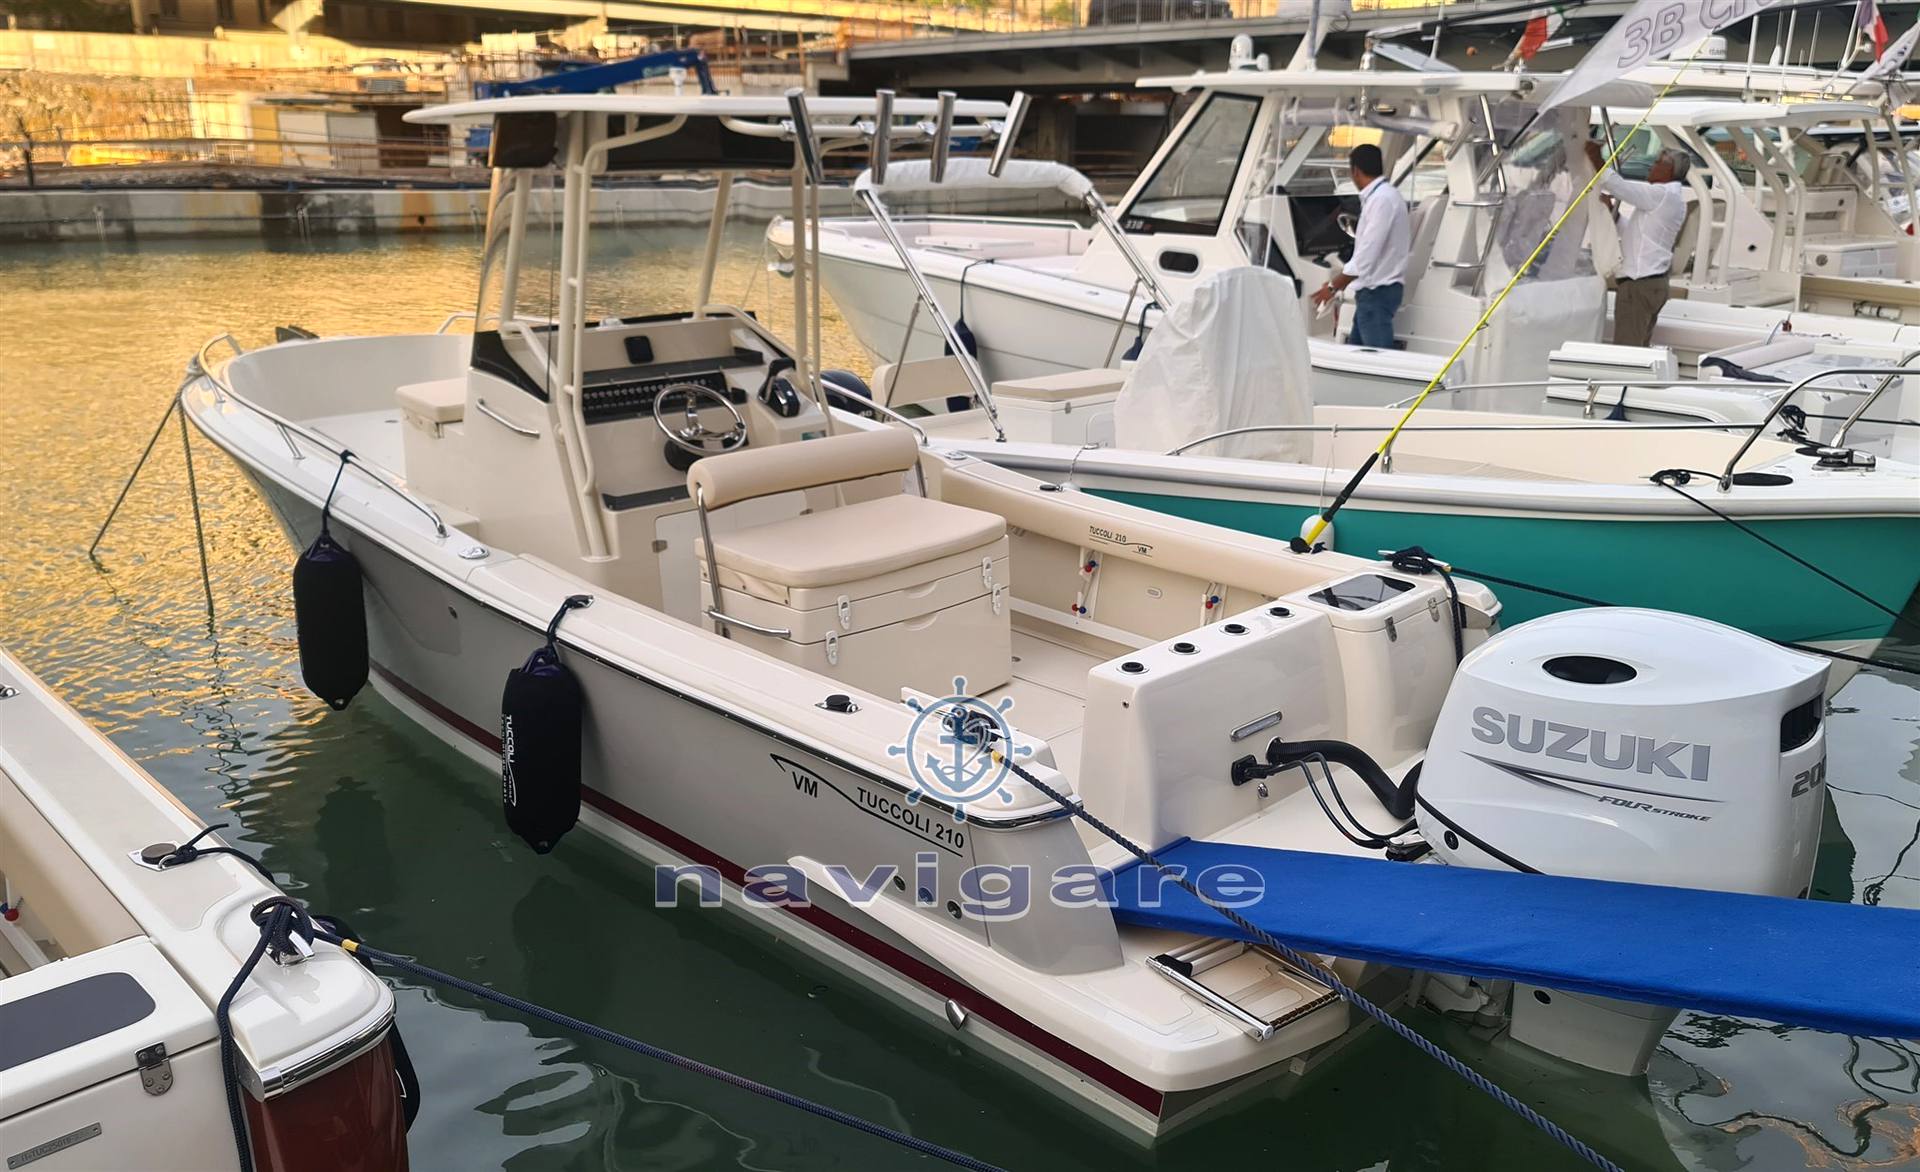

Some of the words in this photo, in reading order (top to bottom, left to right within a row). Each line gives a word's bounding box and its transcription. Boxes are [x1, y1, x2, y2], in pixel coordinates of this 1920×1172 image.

[1618, 3, 1685, 68] 3B
[1089, 525, 1113, 539] TUCCOLI
[1114, 533, 1127, 543] 210
[506, 714, 515, 763] TUCCOLI
[1471, 706, 1711, 782] SUZUKI
[792, 771, 818, 798] VM
[1599, 796, 1653, 812] FOUR
[1652, 808, 1712, 821] STROKE
[857, 787, 930, 833] TUCCOLI
[936, 823, 964, 848] 210
